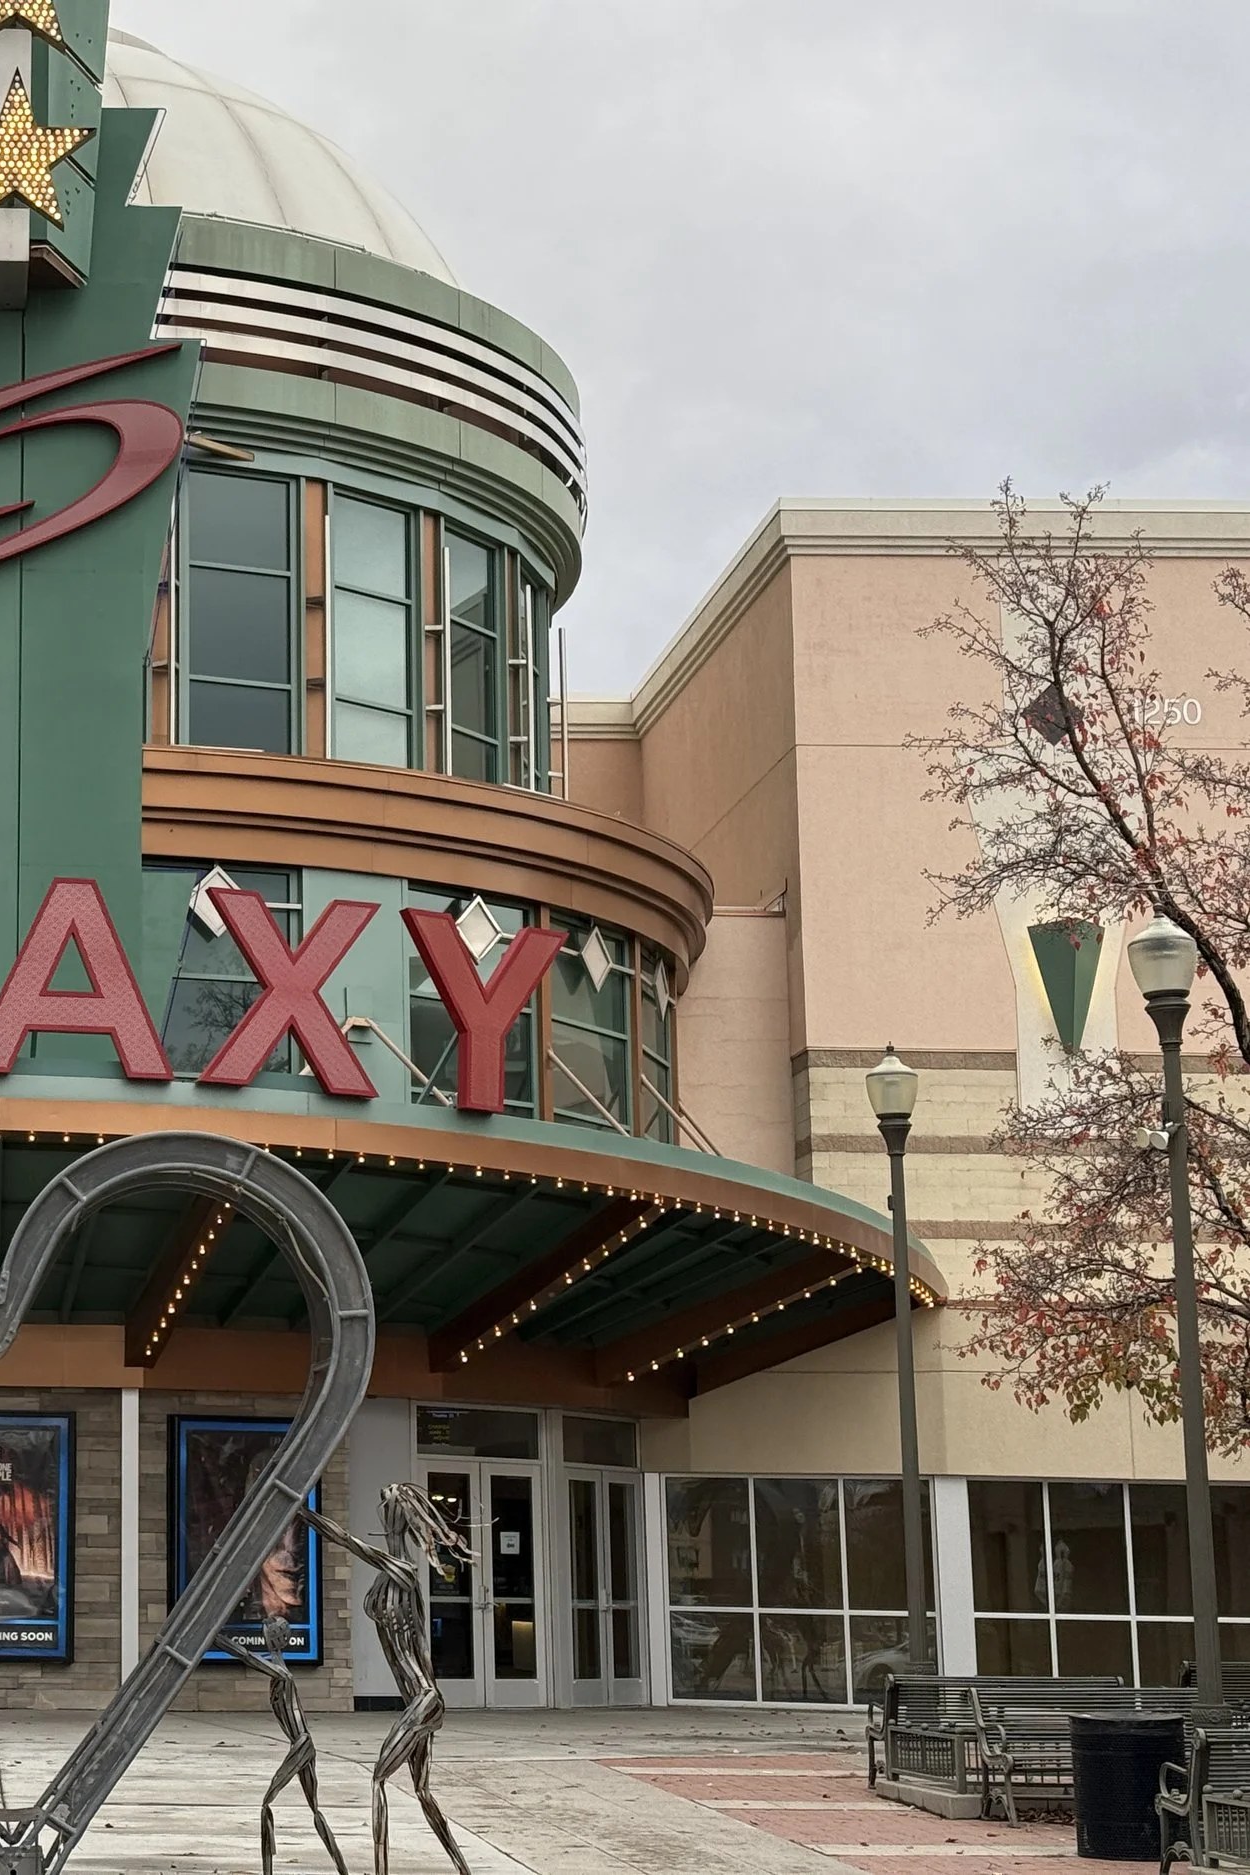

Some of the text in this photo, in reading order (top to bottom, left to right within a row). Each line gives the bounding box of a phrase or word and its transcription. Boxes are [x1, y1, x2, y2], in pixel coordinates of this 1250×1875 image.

[1133, 698, 1202, 725] 1250
[20, 1631, 53, 1641] SOON
[231, 1636, 266, 1646] COMIN
